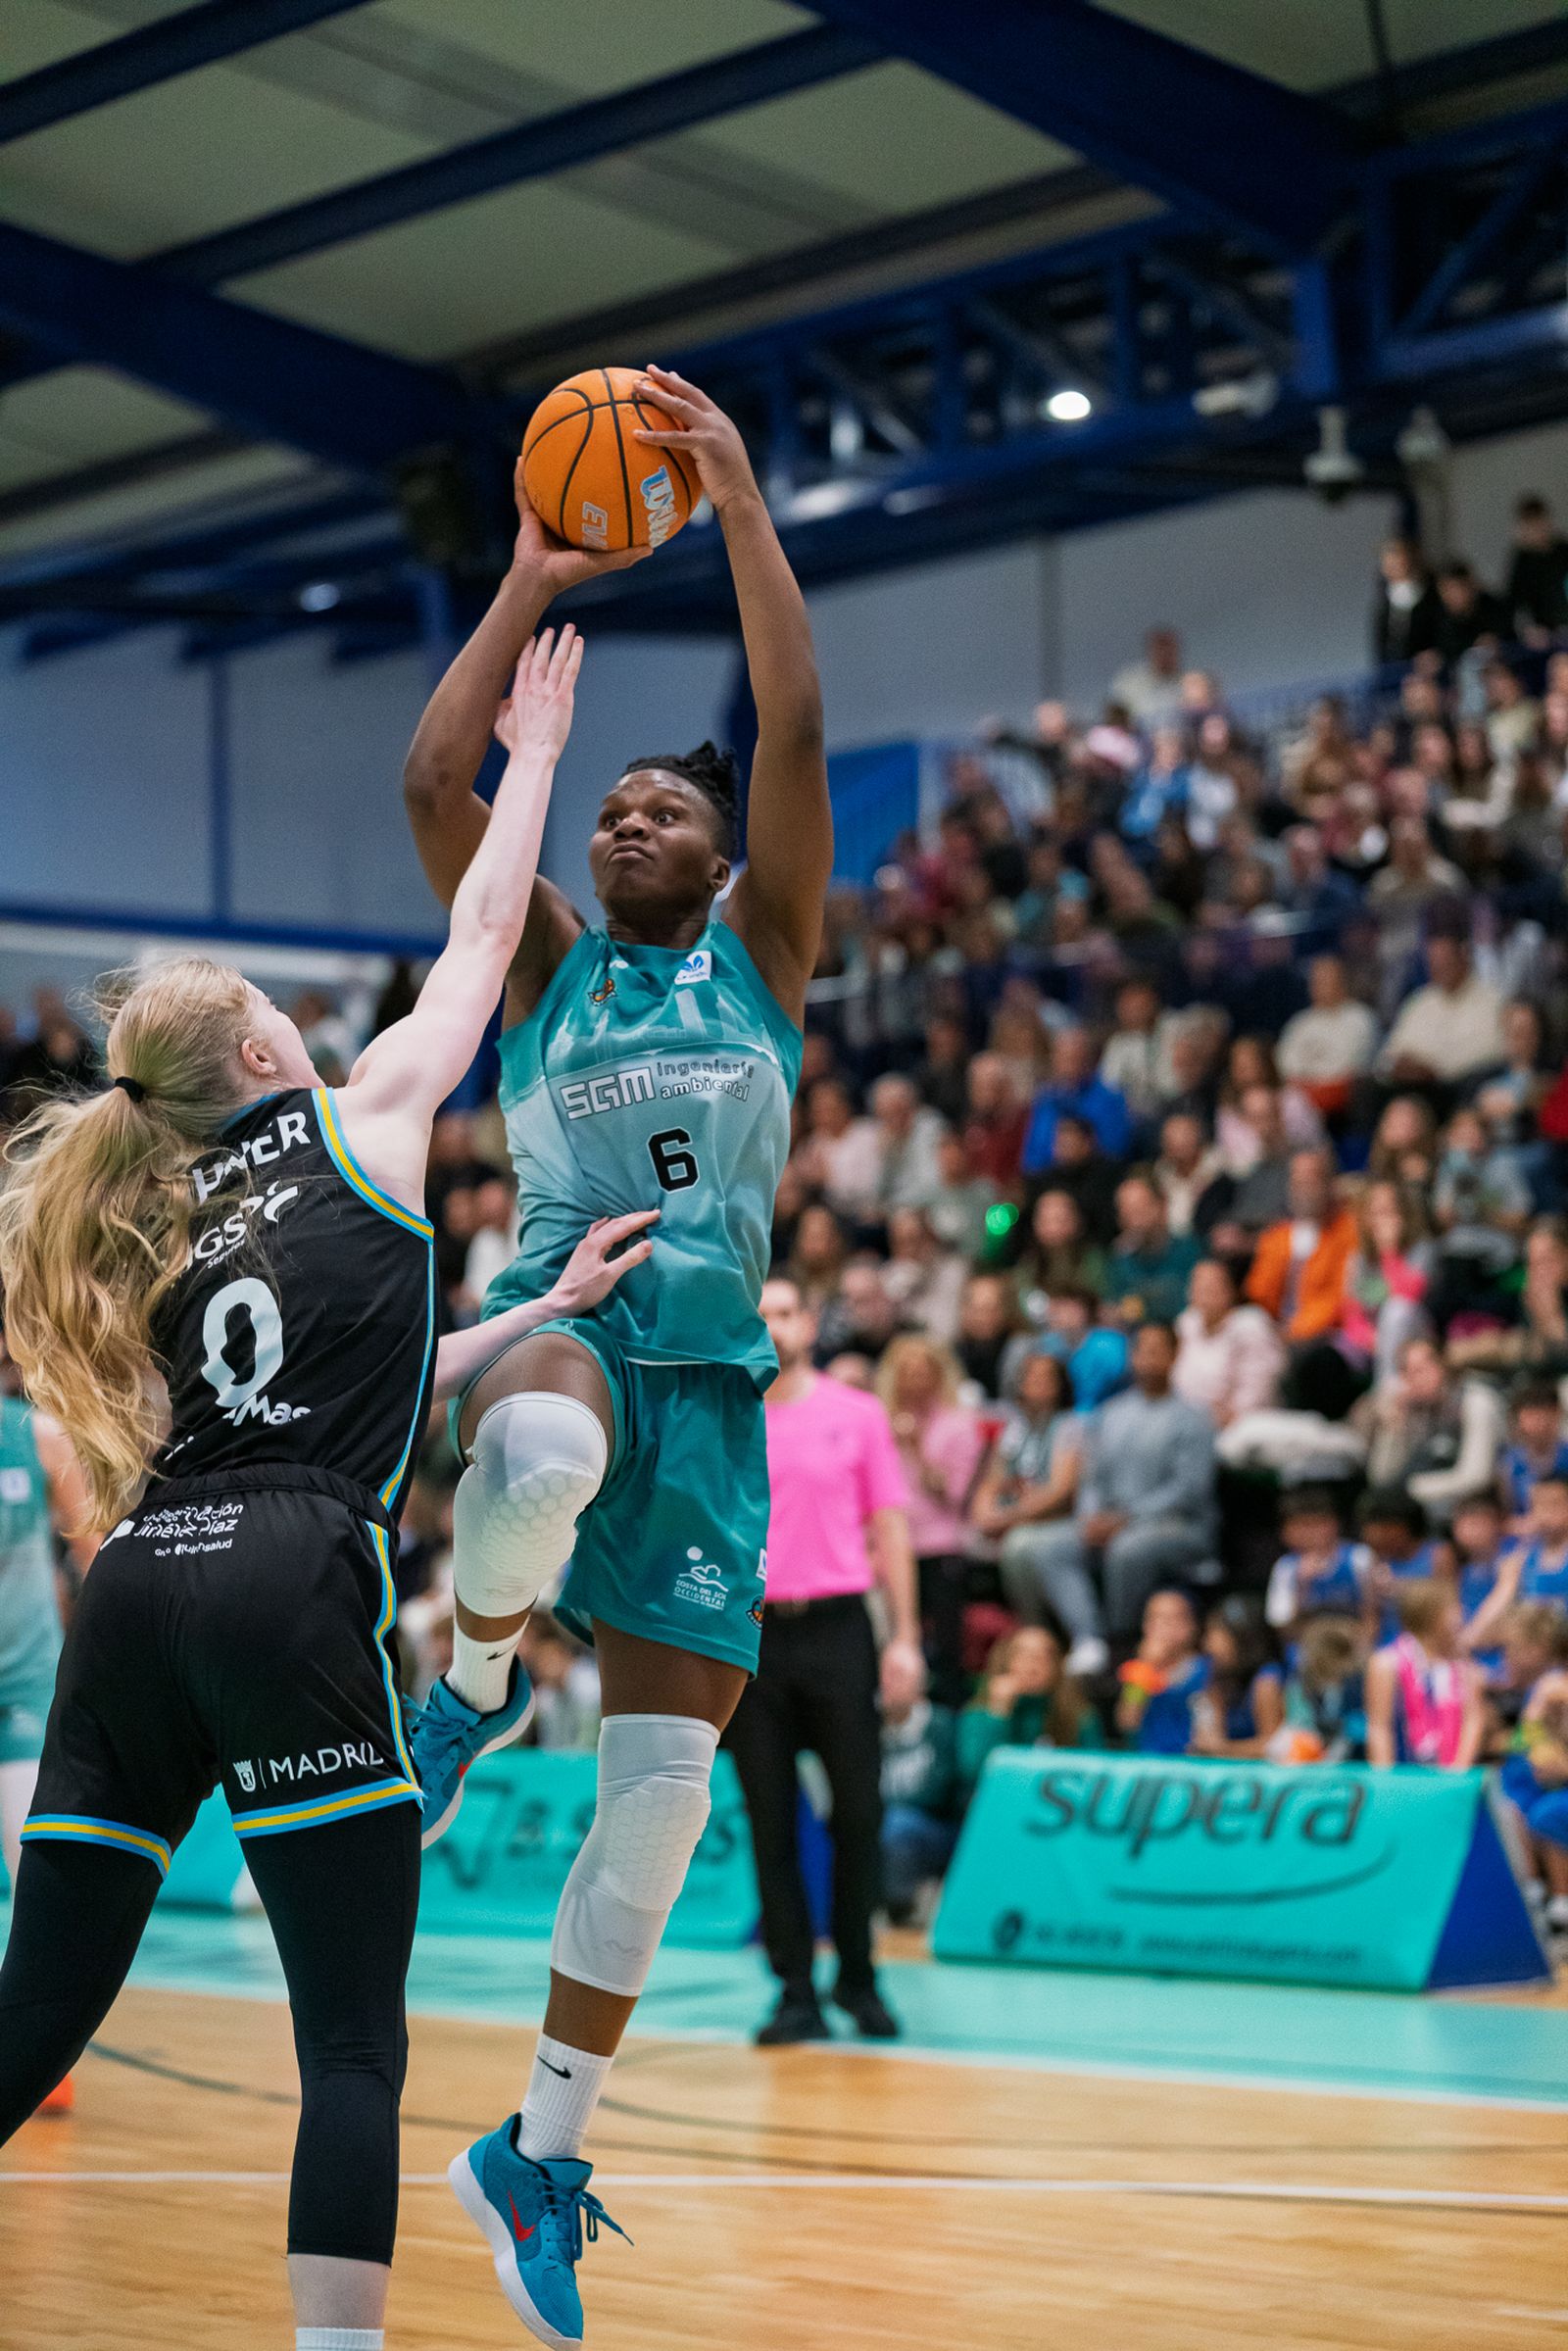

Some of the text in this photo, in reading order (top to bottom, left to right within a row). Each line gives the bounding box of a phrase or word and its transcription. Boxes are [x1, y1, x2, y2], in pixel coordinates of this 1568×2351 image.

[560, 1066, 656, 1120] SGM
[661, 1076, 750, 1102] ambiental
[647, 1126, 699, 1194] 6
[186, 1212, 248, 1271] GS
[201, 1277, 284, 1408] 0
[674, 1586, 725, 1608] OCCIDENTAL
[676, 1579, 698, 1592] COSTA
[1024, 1768, 1367, 1860] supera
